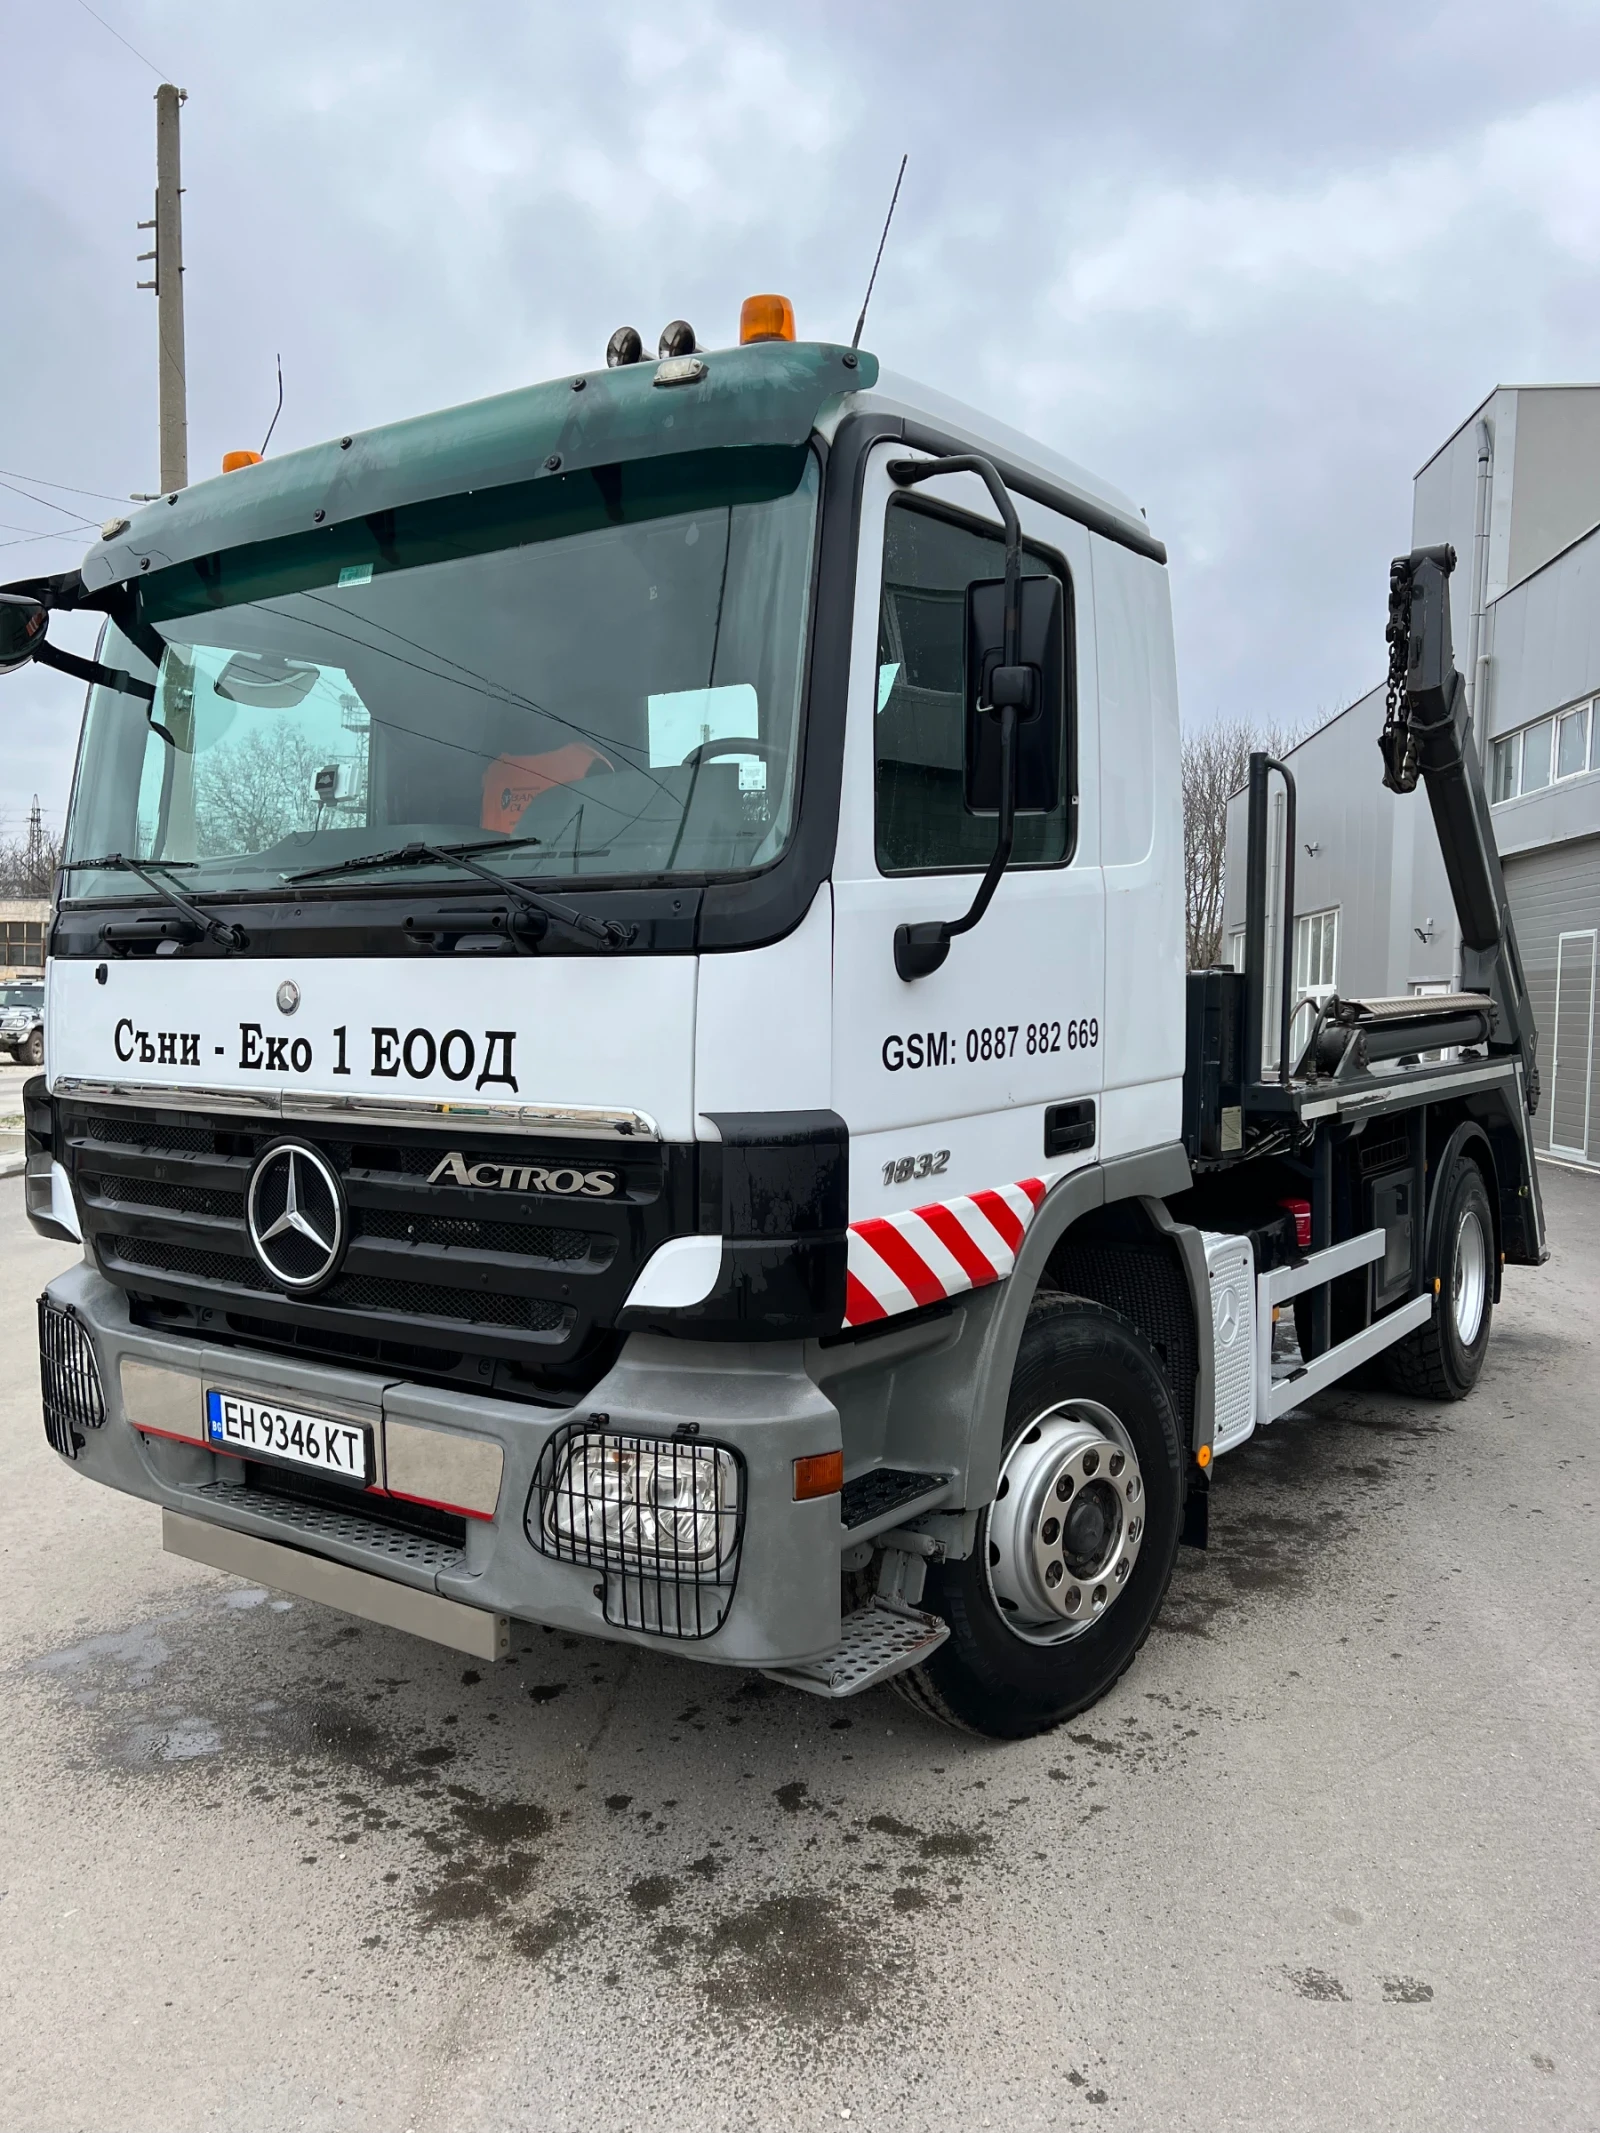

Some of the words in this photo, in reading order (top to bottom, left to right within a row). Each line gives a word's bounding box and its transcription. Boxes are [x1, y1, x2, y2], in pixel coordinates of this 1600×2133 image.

[114, 1018, 201, 1066] Съни
[239, 1023, 313, 1073] Еко
[332, 1025, 352, 1075] 1
[370, 1027, 519, 1094] ЕООД
[881, 1031, 956, 1072] GSM:
[965, 1025, 1020, 1063] 0887
[1026, 1021, 1061, 1056] 882
[1067, 1017, 1099, 1050] 669
[881, 1149, 951, 1186] 1832
[211, 1420, 222, 1433] BG
